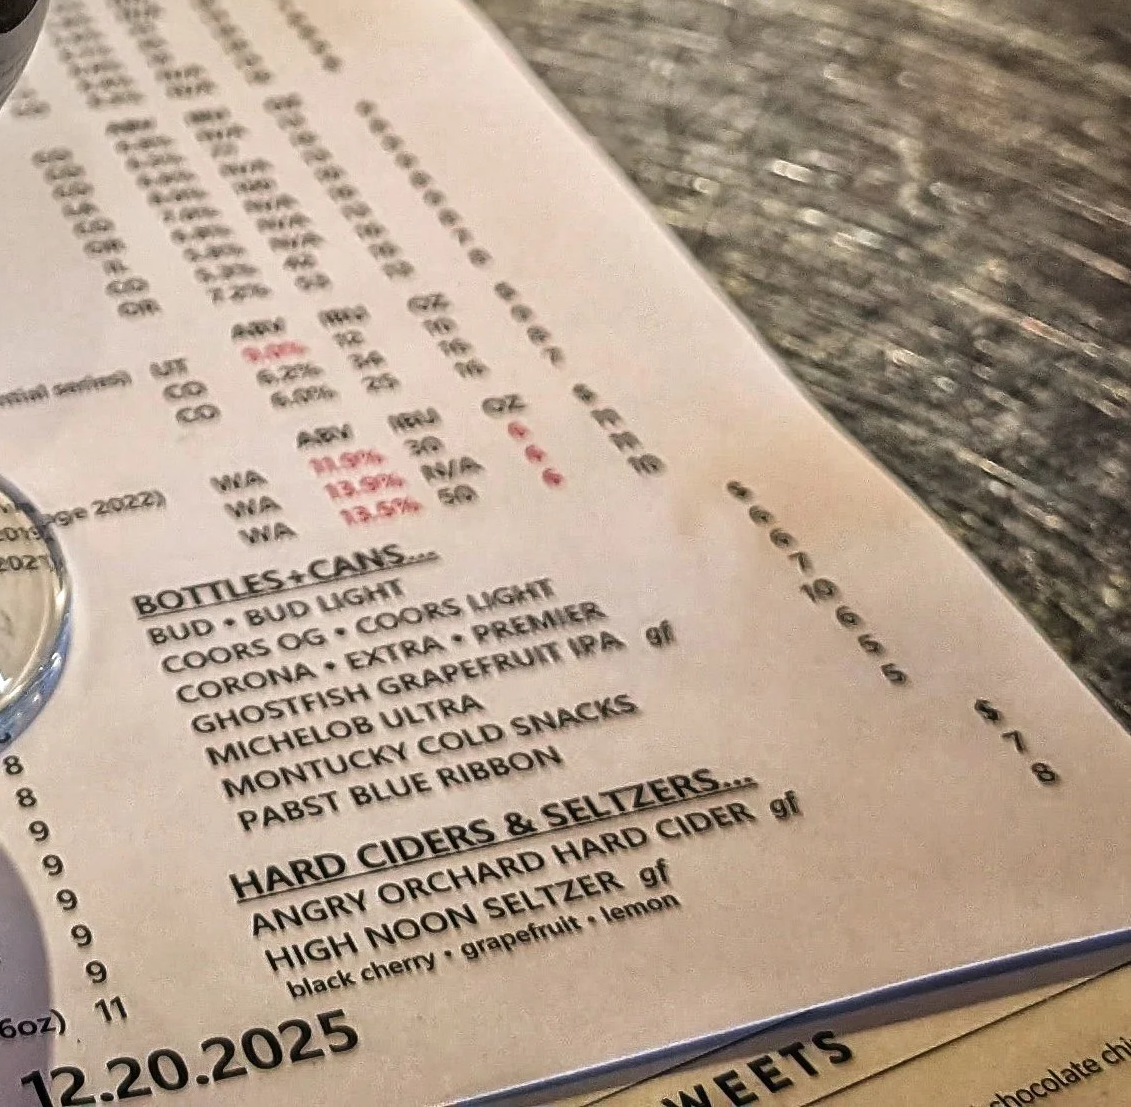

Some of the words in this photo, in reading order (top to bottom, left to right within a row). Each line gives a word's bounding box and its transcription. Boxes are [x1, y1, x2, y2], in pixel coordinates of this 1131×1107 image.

[237, 521, 299, 545] WA
[146, 617, 215, 646] BUD
[244, 598, 310, 627] BUD
[317, 577, 406, 613] LIGHT
[161, 637, 272, 675] COORS
[277, 626, 327, 651] OG
[355, 597, 462, 636] COORS
[466, 576, 556, 613] LIGHT
[175, 661, 317, 705] CORONA
[343, 634, 446, 672] EXTRA
[470, 599, 609, 644] PREMIER
[190, 682, 372, 734] GHOSTFISH
[375, 641, 564, 697] GRAPEFRUIT
[566, 629, 628, 659] IPA
[644, 619, 675, 649] gf
[1, 754, 25, 777] 8
[204, 715, 375, 768] MICHELOB
[378, 693, 487, 730] ULTRA
[220, 740, 409, 799] MONTUCKY
[417, 722, 505, 756] COLD
[509, 693, 640, 737] SNACKS
[15, 786, 38, 809] 8
[237, 790, 339, 833] PABST
[348, 772, 433, 808] BLUE
[435, 744, 565, 789] RIBBON
[28, 819, 51, 842] 9
[41, 853, 64, 877] 9
[228, 851, 348, 901] HARD
[355, 818, 496, 871] CIDERS
[502, 810, 539, 837] &
[540, 767, 758, 829] SELTZERS...
[251, 888, 367, 938] ANGRY
[376, 850, 547, 906] ORCHARD
[550, 825, 648, 865] HARD
[654, 800, 758, 841] CIDER
[768, 789, 802, 820] gf
[1001, 729, 1027, 754] 7
[263, 930, 360, 973] HIGH
[363, 902, 479, 950] NOON
[481, 869, 626, 919] SELTZER
[638, 857, 671, 889] gf
[1030, 761, 1060, 786] 8
[56, 888, 79, 912] 9
[70, 923, 93, 948] 9
[85, 959, 108, 984] 9
[285, 968, 357, 1001] black
[359, 950, 437, 983] cherry
[459, 913, 584, 961] grapefruit
[598, 893, 682, 923] lemon
[94, 995, 129, 1023] 11
[20, 1008, 360, 1107] 12.20.2025
